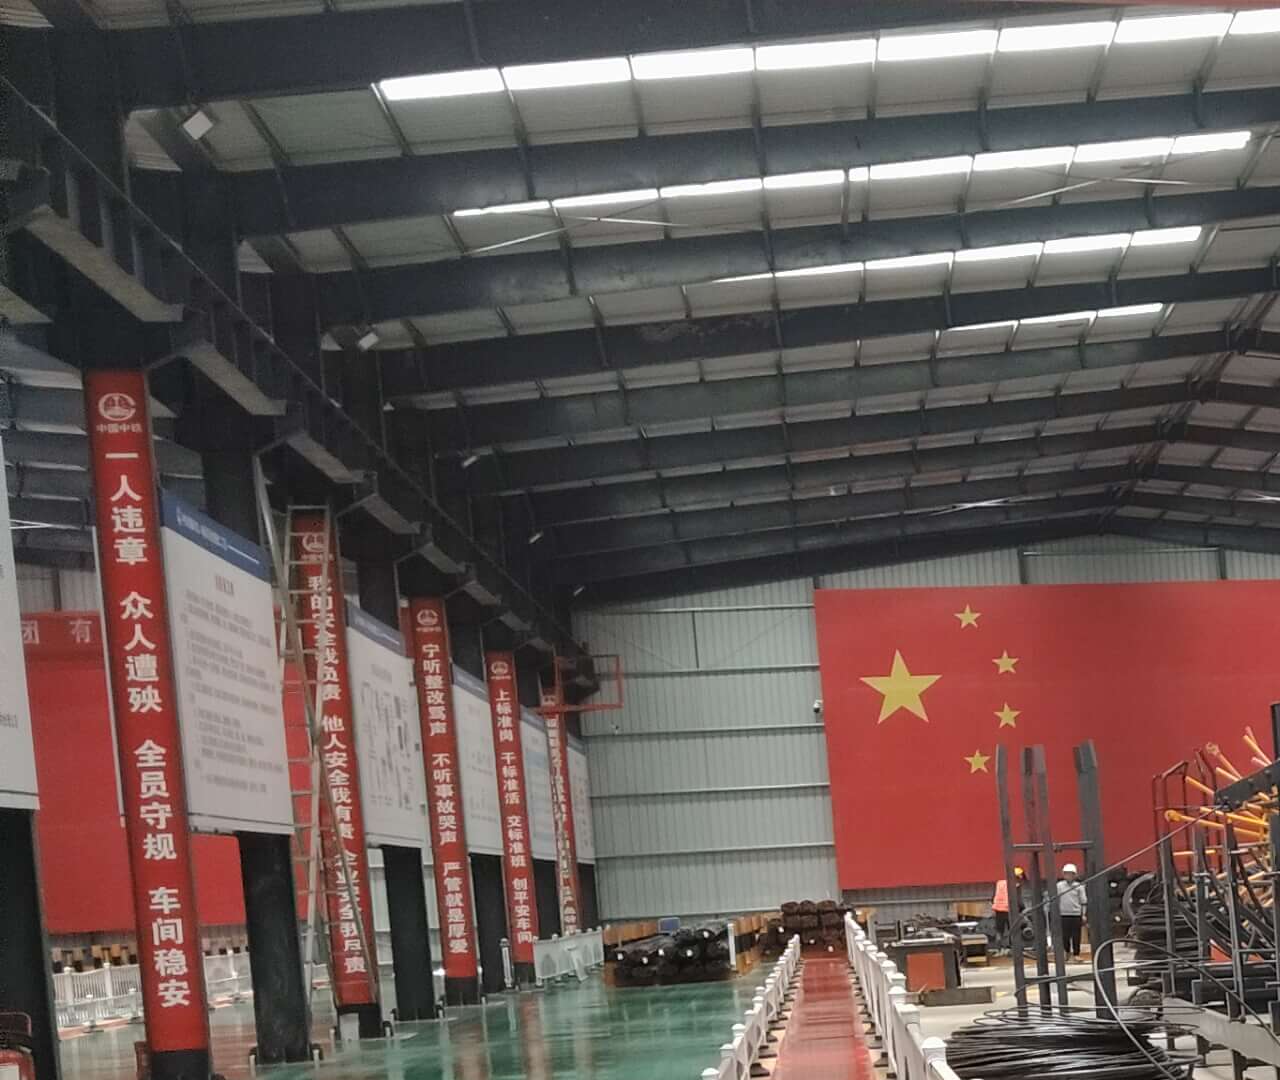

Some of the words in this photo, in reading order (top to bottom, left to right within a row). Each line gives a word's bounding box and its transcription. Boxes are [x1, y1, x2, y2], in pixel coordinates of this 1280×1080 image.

[105, 453, 149, 566] 一人违章
[120, 591, 162, 713] 众人遭殃
[134, 739, 177, 861] 全员守规
[432, 753, 457, 846] 不听事故哭声
[149, 886, 191, 1008] 车间稳安
[443, 861, 468, 954] 严管就是厚爱
